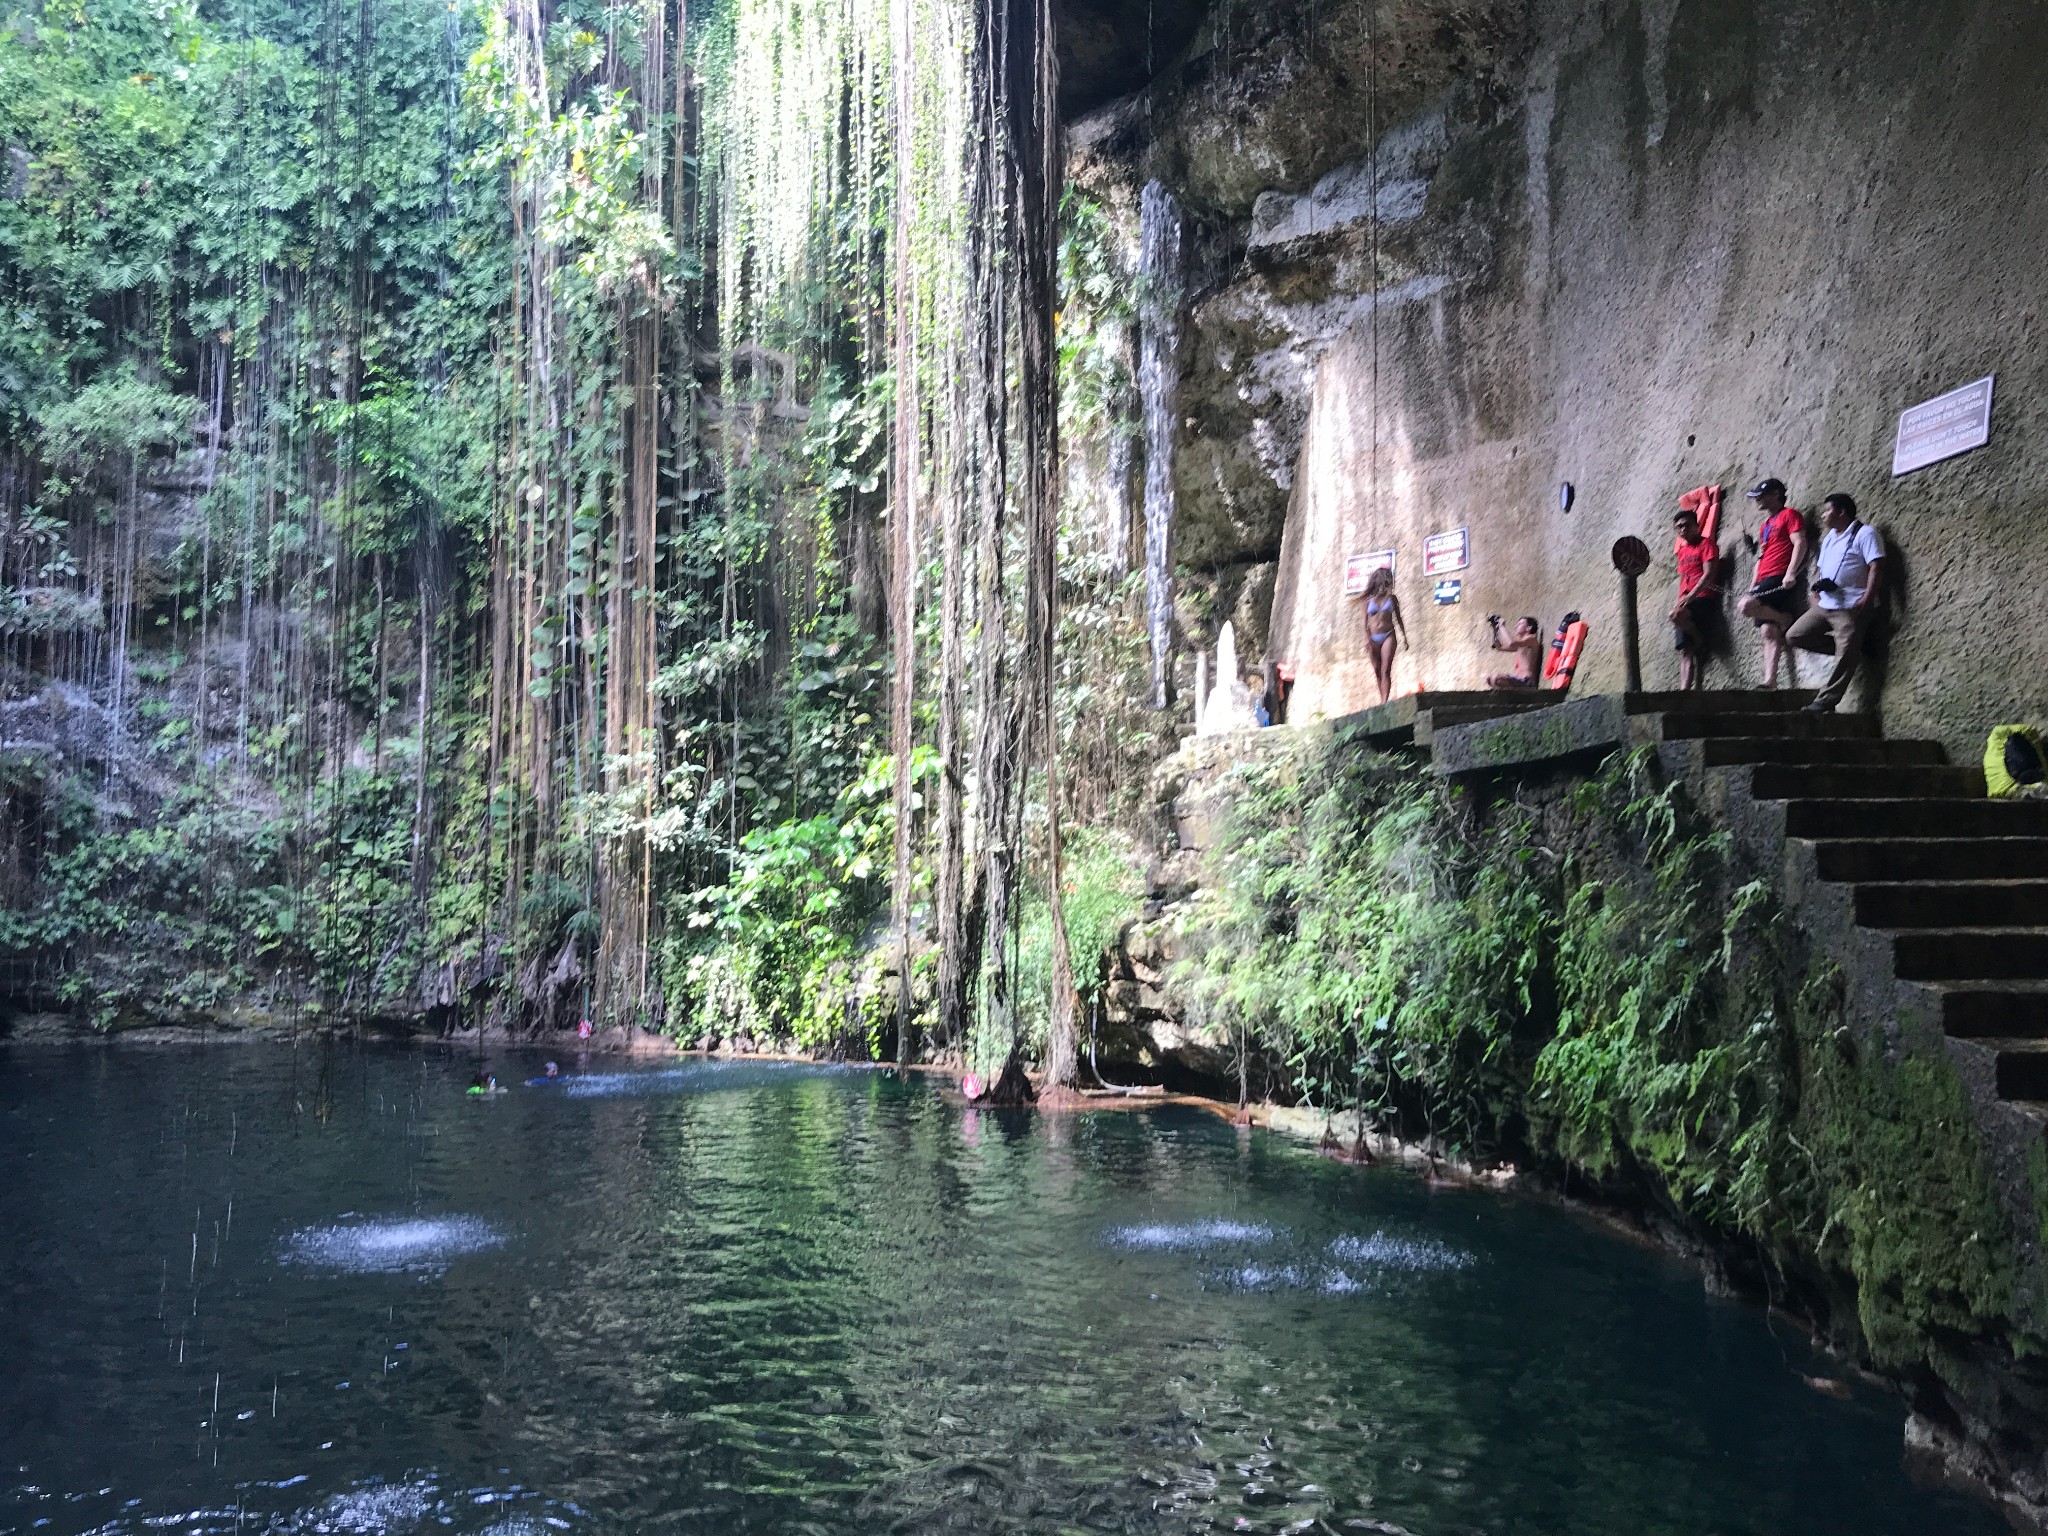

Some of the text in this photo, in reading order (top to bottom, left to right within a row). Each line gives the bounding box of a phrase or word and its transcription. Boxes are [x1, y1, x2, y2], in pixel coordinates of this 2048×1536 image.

[1902, 426, 1916, 436] LAS
[1964, 399, 1984, 412] AGUA
[1922, 406, 1944, 420] FAVOR
[1958, 390, 1983, 405] TOCAR
[1905, 436, 1930, 452] PLEASE
[1954, 420, 1976, 434] TOUCH
[1912, 444, 1934, 458] ROOTS
[1945, 436, 1957, 446] THE
[1959, 426, 1983, 441] WATER
